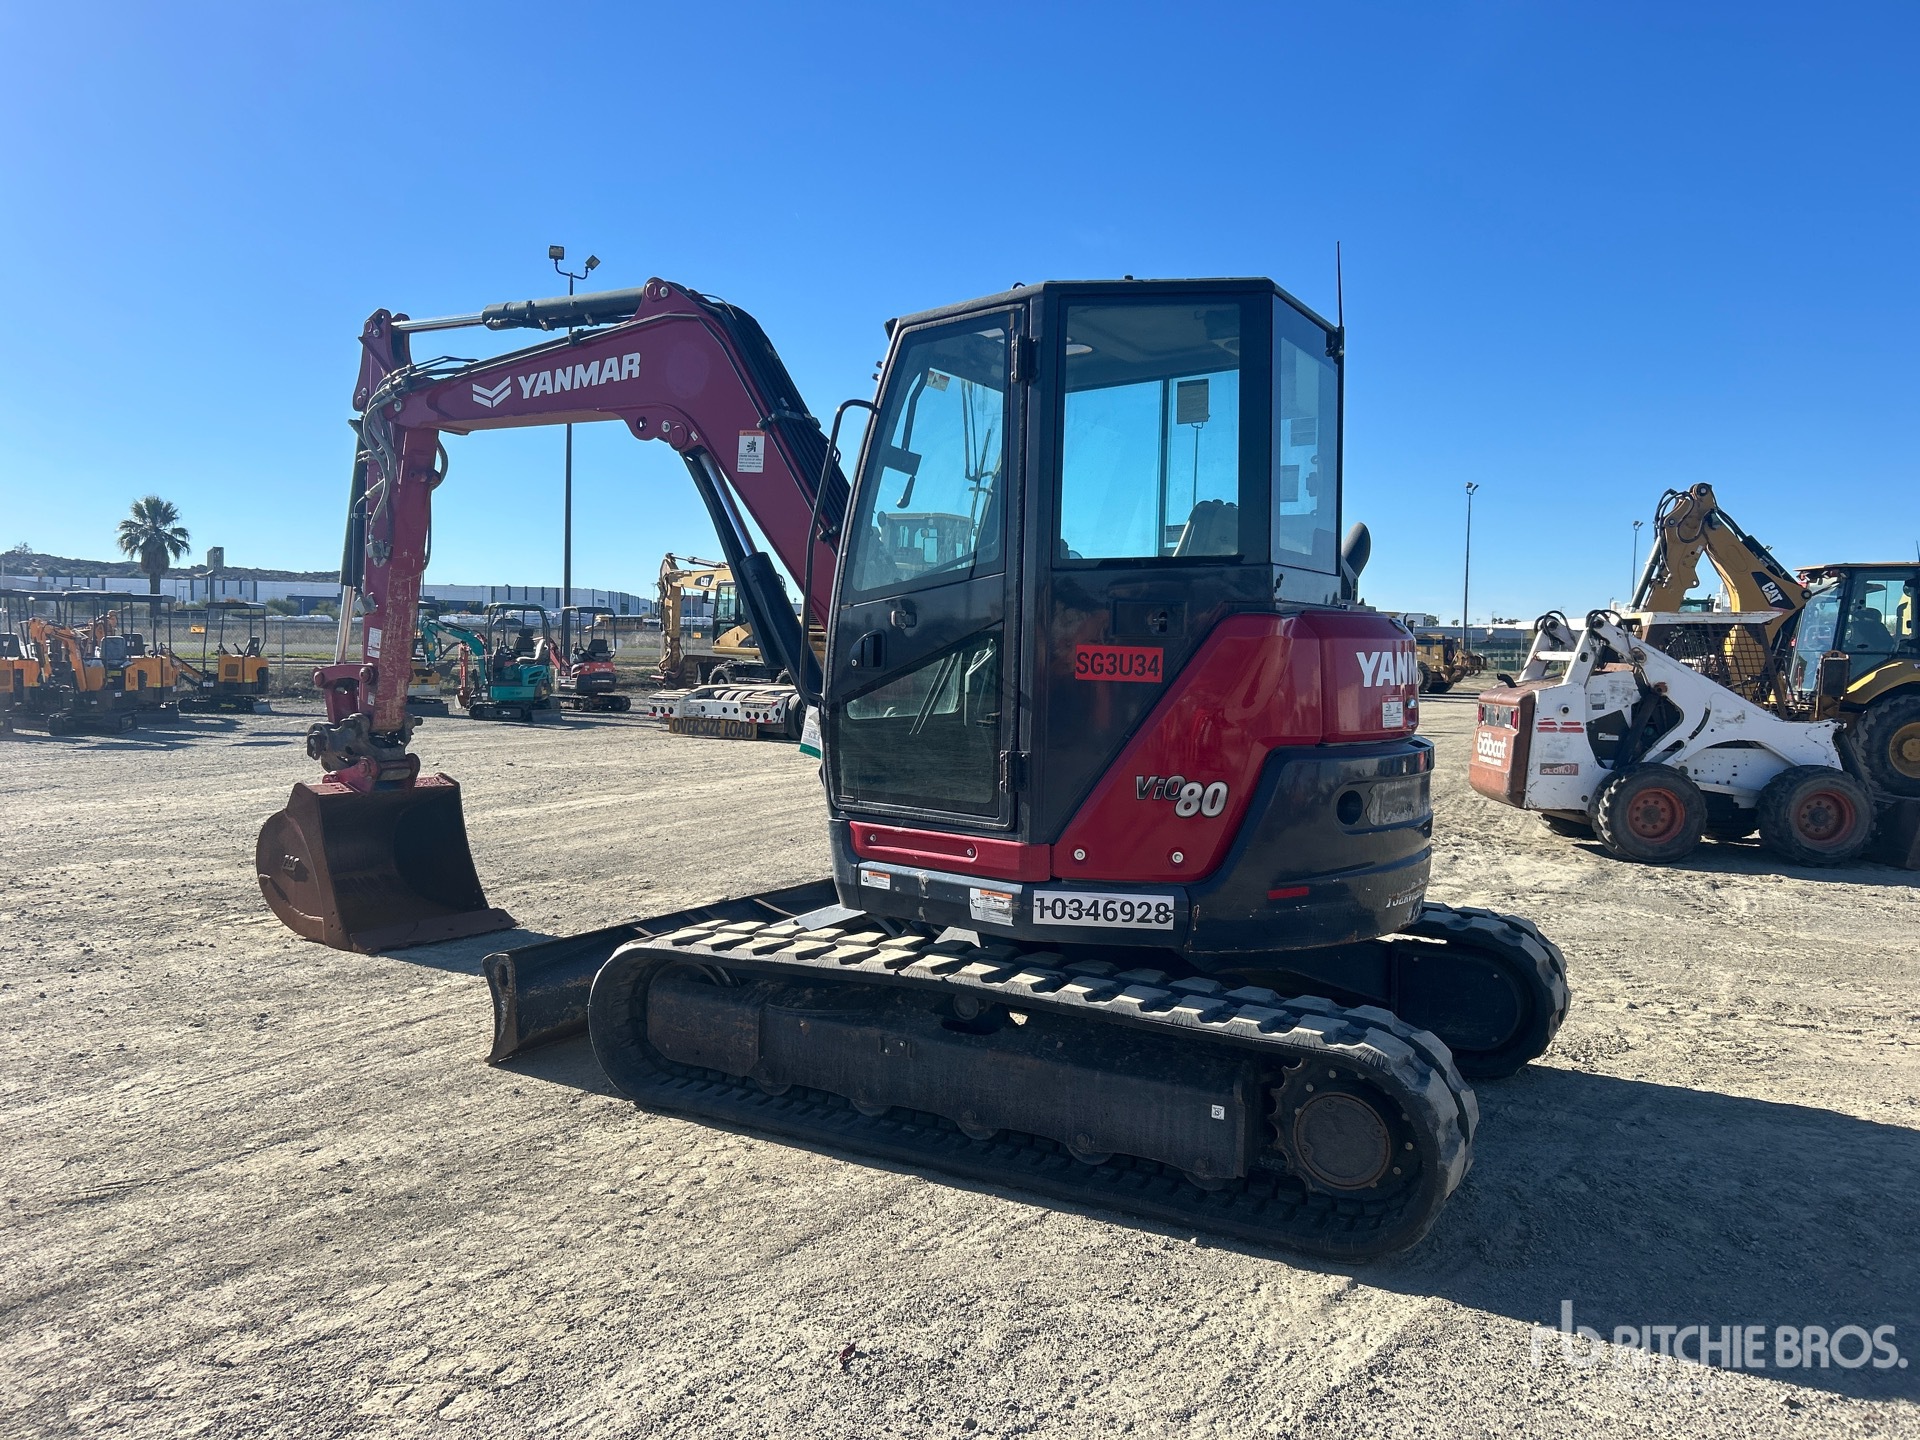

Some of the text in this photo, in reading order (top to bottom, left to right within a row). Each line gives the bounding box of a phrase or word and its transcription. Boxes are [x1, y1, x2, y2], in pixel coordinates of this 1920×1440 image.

[517, 352, 641, 399] YANMAR
[700, 577, 710, 587] CAT
[1761, 581, 1783, 604] CAT
[1075, 651, 1160, 677] SG3U34
[672, 717, 754, 739] OVERSIZE LOAD
[1477, 731, 1507, 759] bobcat
[1174, 780, 1230, 818] 80
[1035, 897, 1171, 925] 10346928
